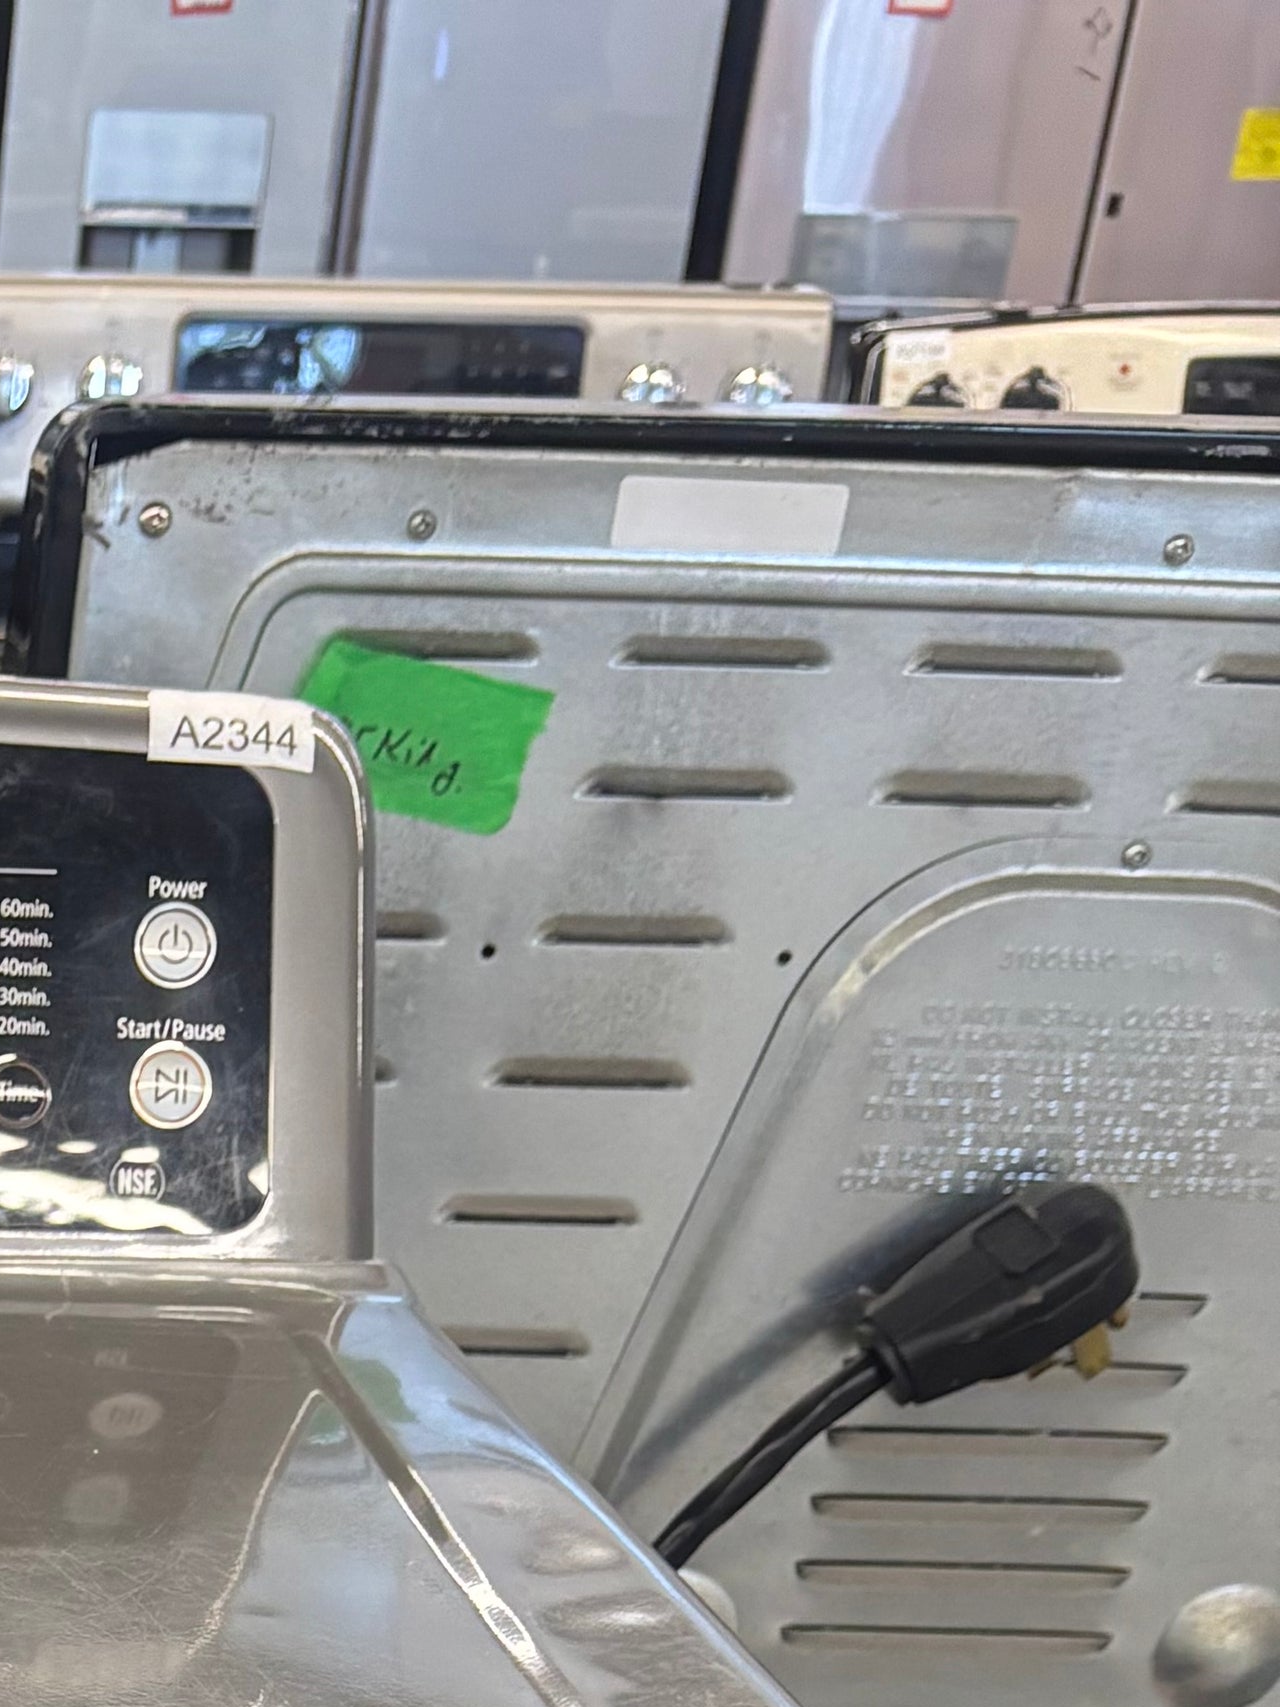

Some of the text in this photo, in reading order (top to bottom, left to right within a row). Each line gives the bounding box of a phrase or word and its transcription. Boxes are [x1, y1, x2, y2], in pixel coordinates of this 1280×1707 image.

[169, 714, 298, 757] A2344
[148, 875, 207, 899] Power
[0, 898, 53, 920] 60min.
[0, 928, 52, 948] 50min.
[117, 1017, 225, 1042] Start/Pause
